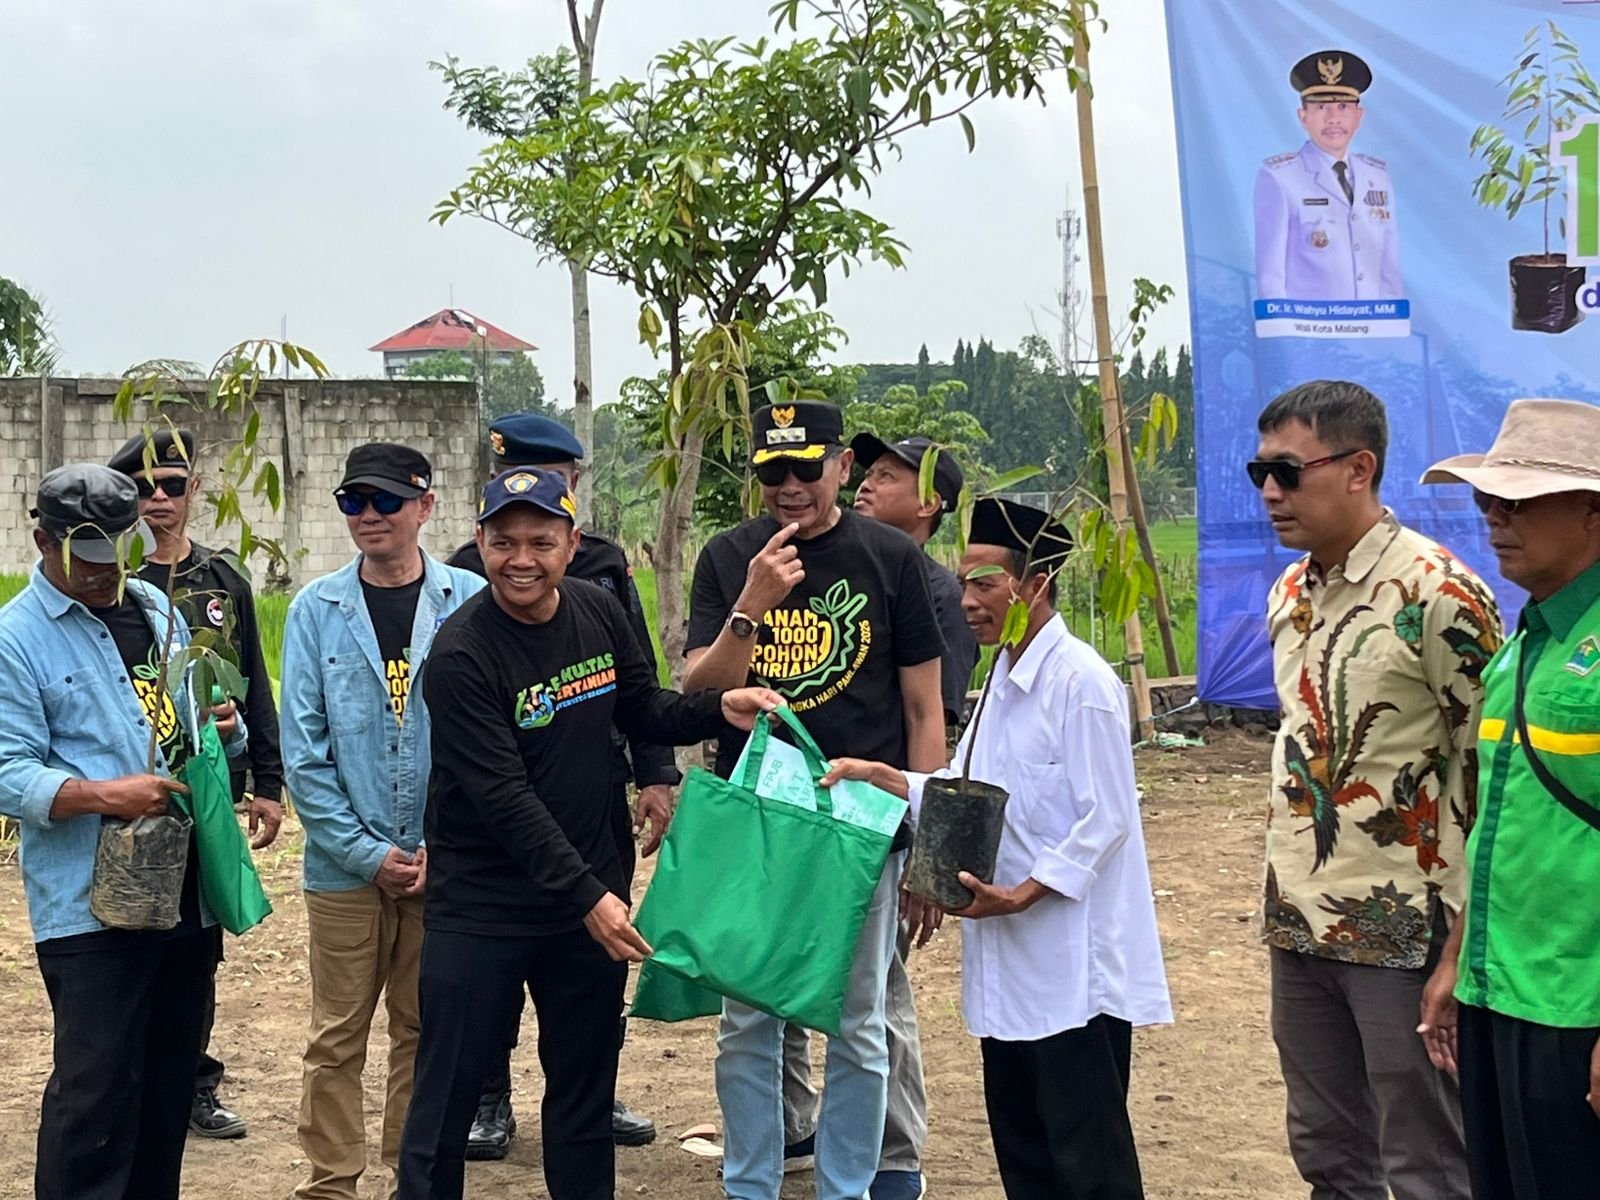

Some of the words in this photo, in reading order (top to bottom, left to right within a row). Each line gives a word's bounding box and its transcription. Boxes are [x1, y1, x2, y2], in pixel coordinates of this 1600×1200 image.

[1266, 303, 1283, 314] Dr.
[1283, 304, 1294, 314] Ir.
[1294, 304, 1327, 317] Wahyu
[1329, 304, 1372, 317] Hidayat,
[1374, 304, 1396, 314] MM
[1294, 323, 1311, 333] Wali
[1312, 324, 1333, 333] Kota
[1335, 324, 1369, 334] Malang
[763, 609, 818, 627] ANAM
[772, 625, 818, 645] 1000
[751, 643, 818, 663] POHON
[749, 661, 818, 678] URIAN
[789, 697, 817, 712] NGKA
[815, 685, 839, 705] HARI
[835, 644, 870, 691] PAHLAWAN
[858, 619, 871, 644] 2025
